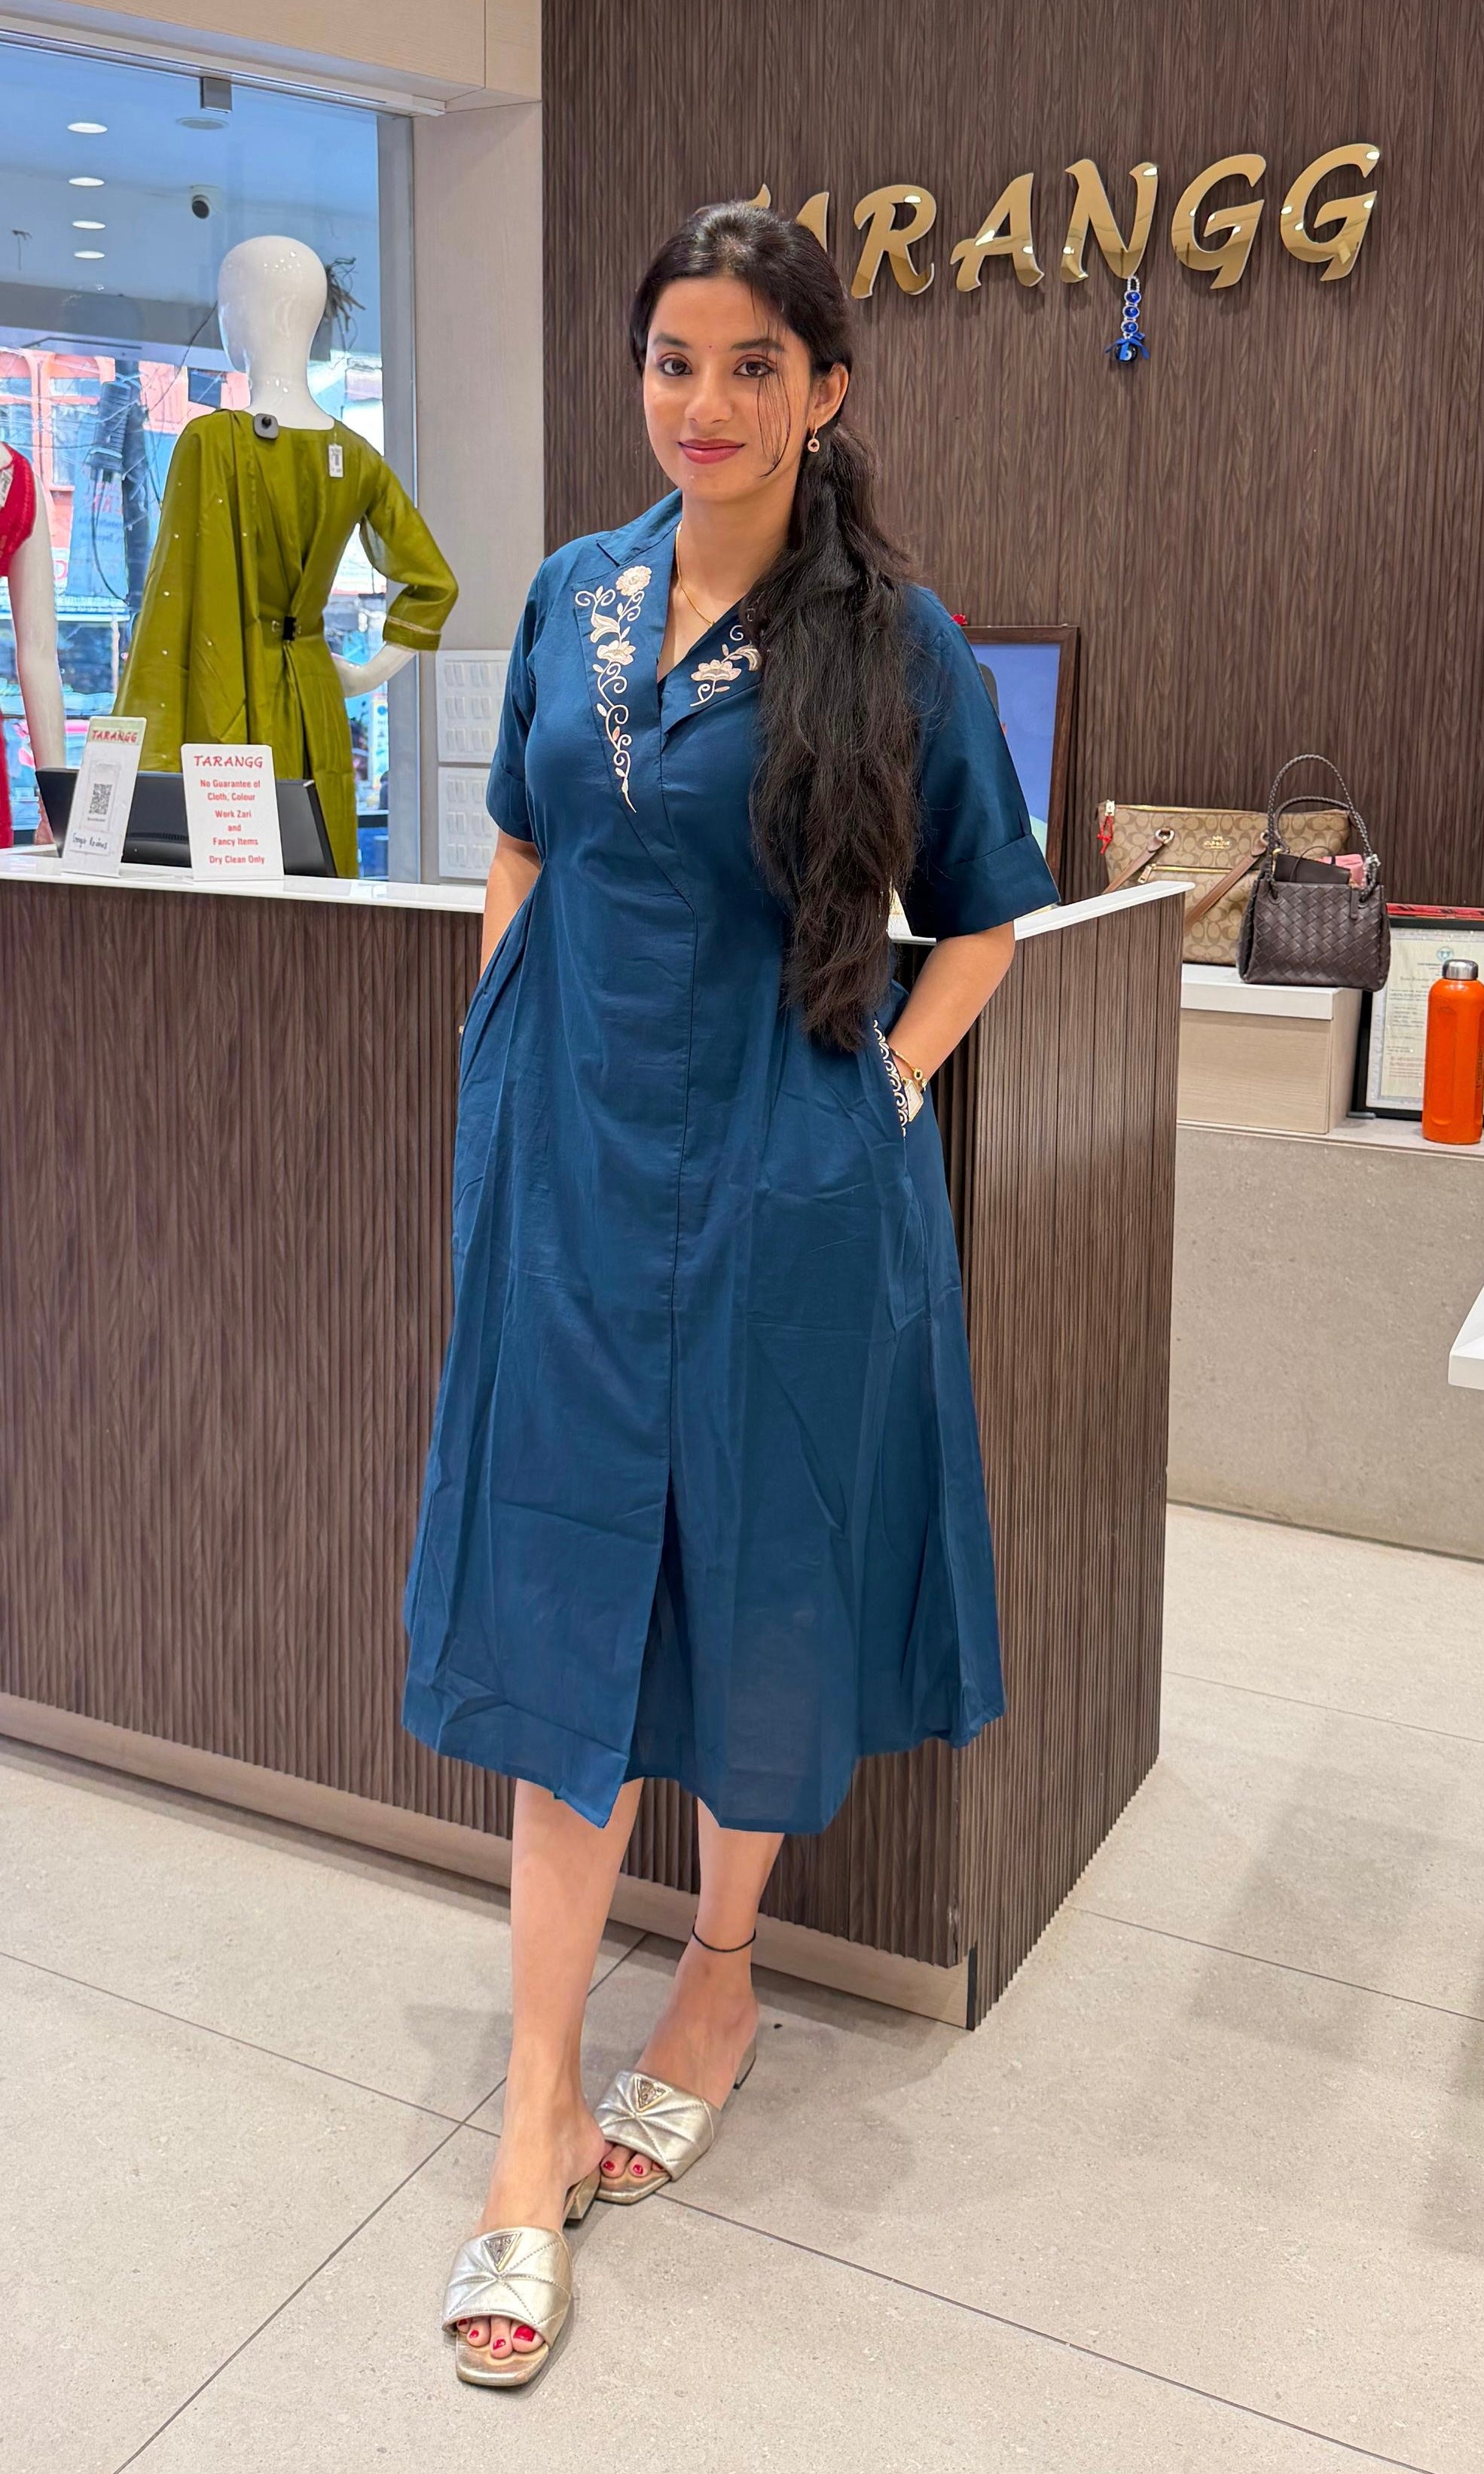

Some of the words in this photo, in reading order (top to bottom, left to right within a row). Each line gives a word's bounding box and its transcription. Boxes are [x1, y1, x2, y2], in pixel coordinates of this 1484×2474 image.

[746, 143, 1380, 300] RANGG
[91, 729, 138, 744] TARANGG
[194, 755, 264, 768] TARANGG
[200, 779, 211, 788] No
[213, 779, 251, 788] Guarantee
[254, 780, 261, 788] of
[231, 793, 255, 802] Colour
[215, 810, 235, 818] Work
[237, 810, 252, 818] Zari
[212, 837, 235, 847] Fancy
[237, 837, 258, 846] Items
[209, 855, 223, 865] Dry
[224, 855, 246, 864] Clean
[248, 855, 265, 864] Only
